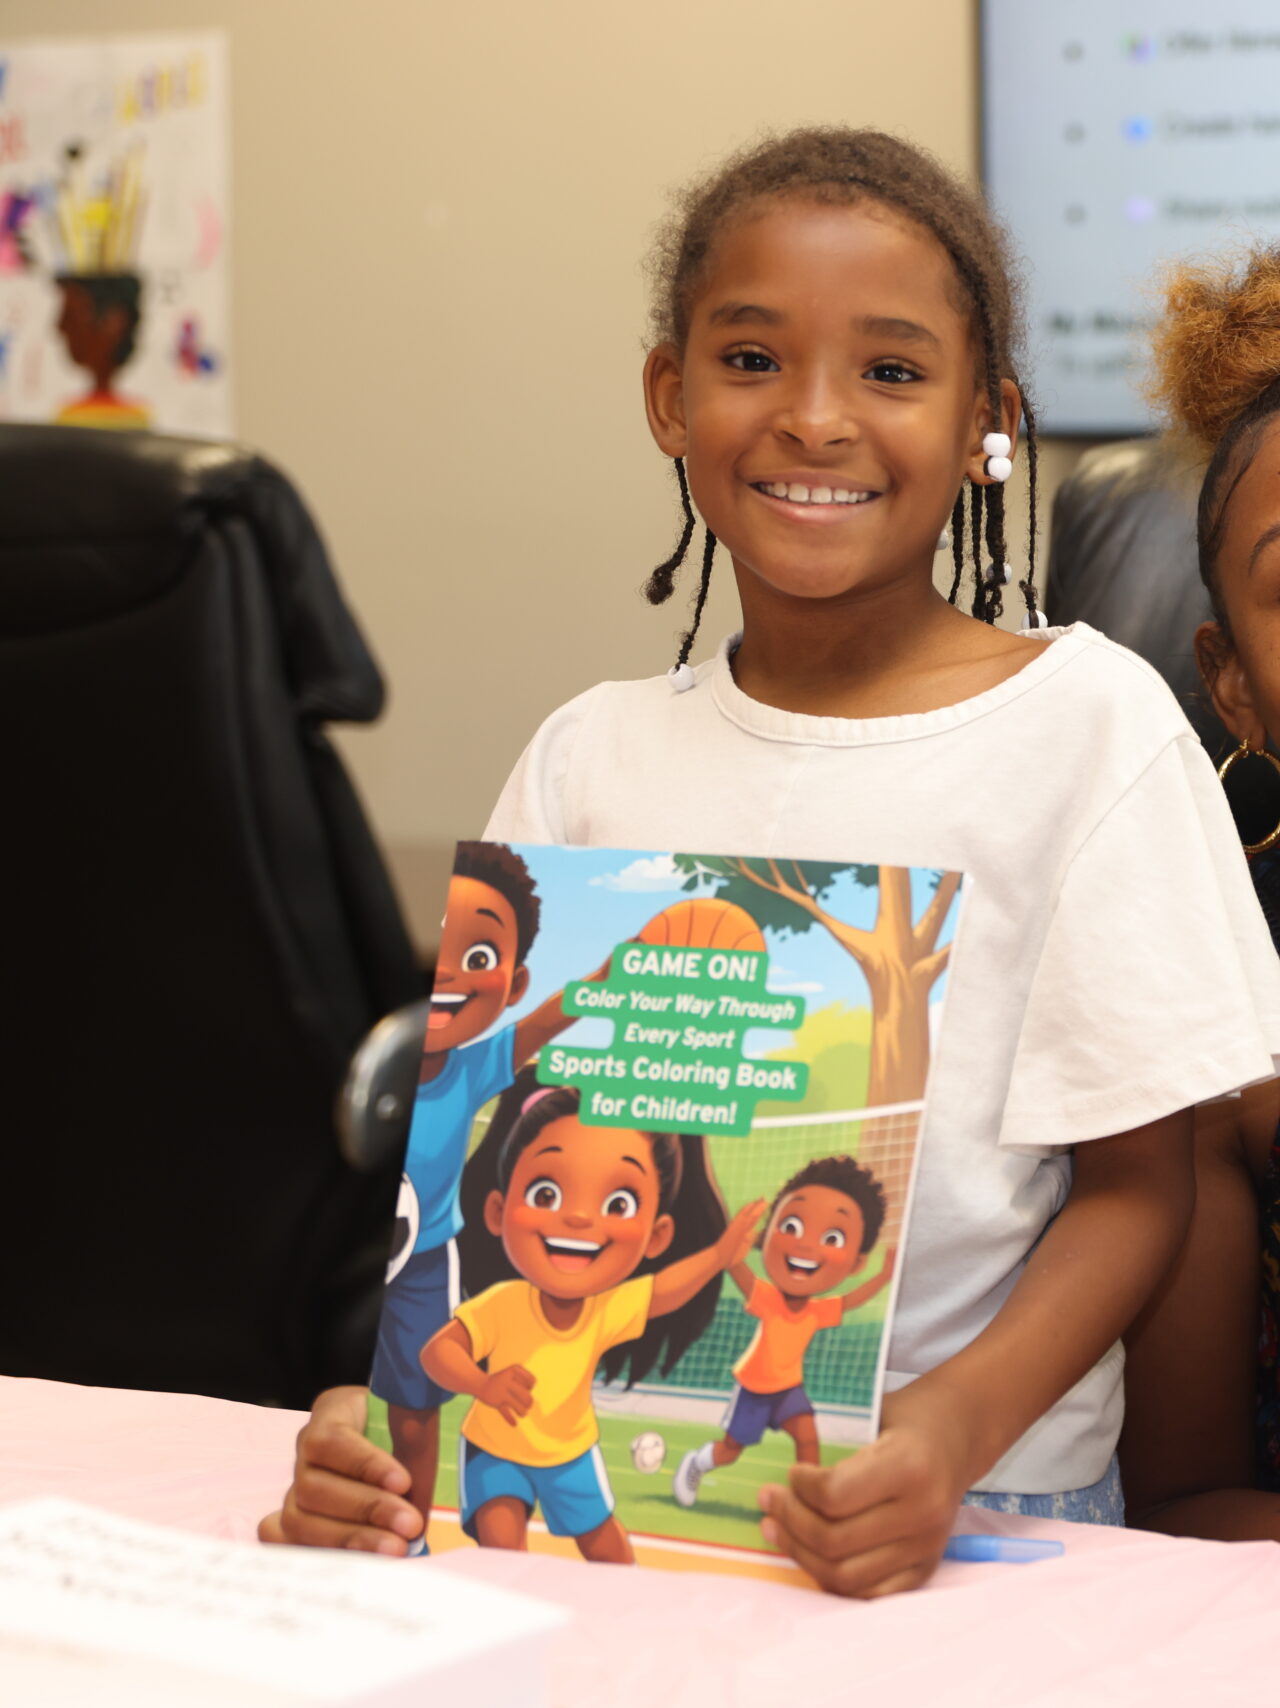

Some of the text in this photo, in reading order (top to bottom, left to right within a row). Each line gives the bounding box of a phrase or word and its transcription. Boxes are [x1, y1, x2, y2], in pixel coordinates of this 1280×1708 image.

[623, 949, 759, 982] GAME ON!
[574, 986, 796, 1023] Color Your Way Through
[624, 1022, 736, 1050] Every Sport
[549, 1049, 797, 1090] Sports Coloring Book
[591, 1092, 738, 1125] for Children!
